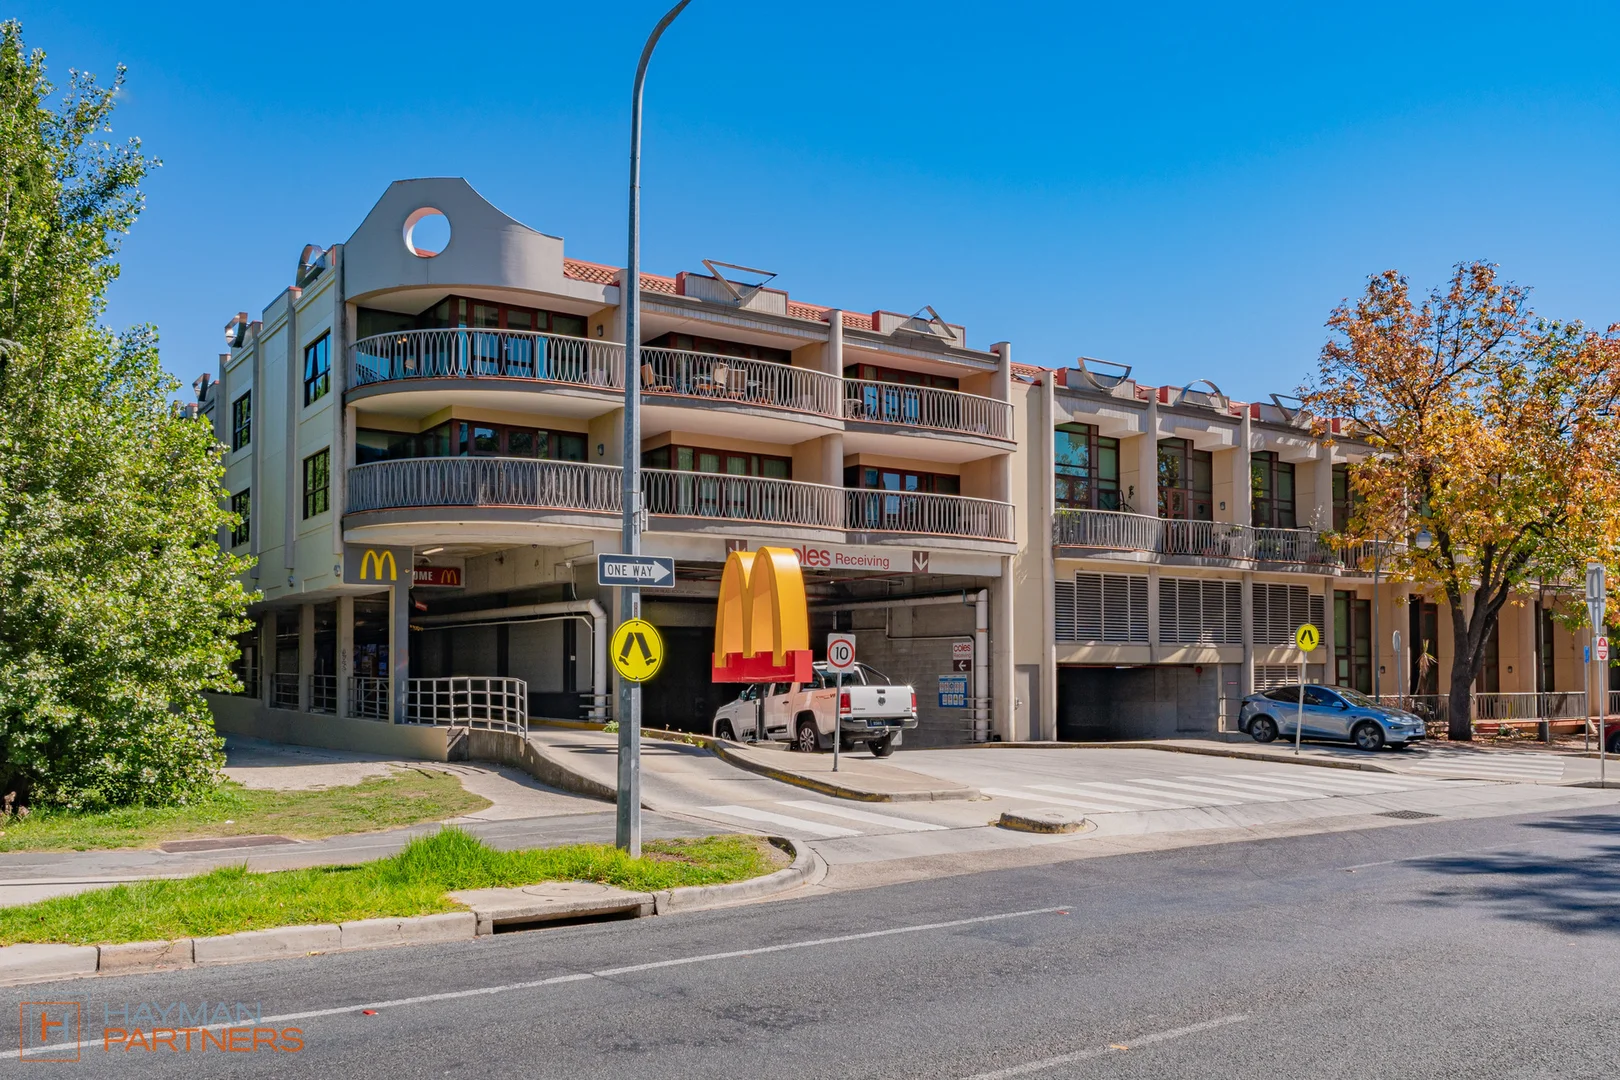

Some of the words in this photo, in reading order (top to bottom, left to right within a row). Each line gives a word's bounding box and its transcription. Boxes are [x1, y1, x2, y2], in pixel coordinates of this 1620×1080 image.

[793, 545, 831, 567] oles
[835, 553, 890, 570] Receiving
[607, 564, 627, 576] ONE
[633, 565, 653, 577] WAY
[835, 646, 849, 660] 10
[953, 643, 971, 652] coles
